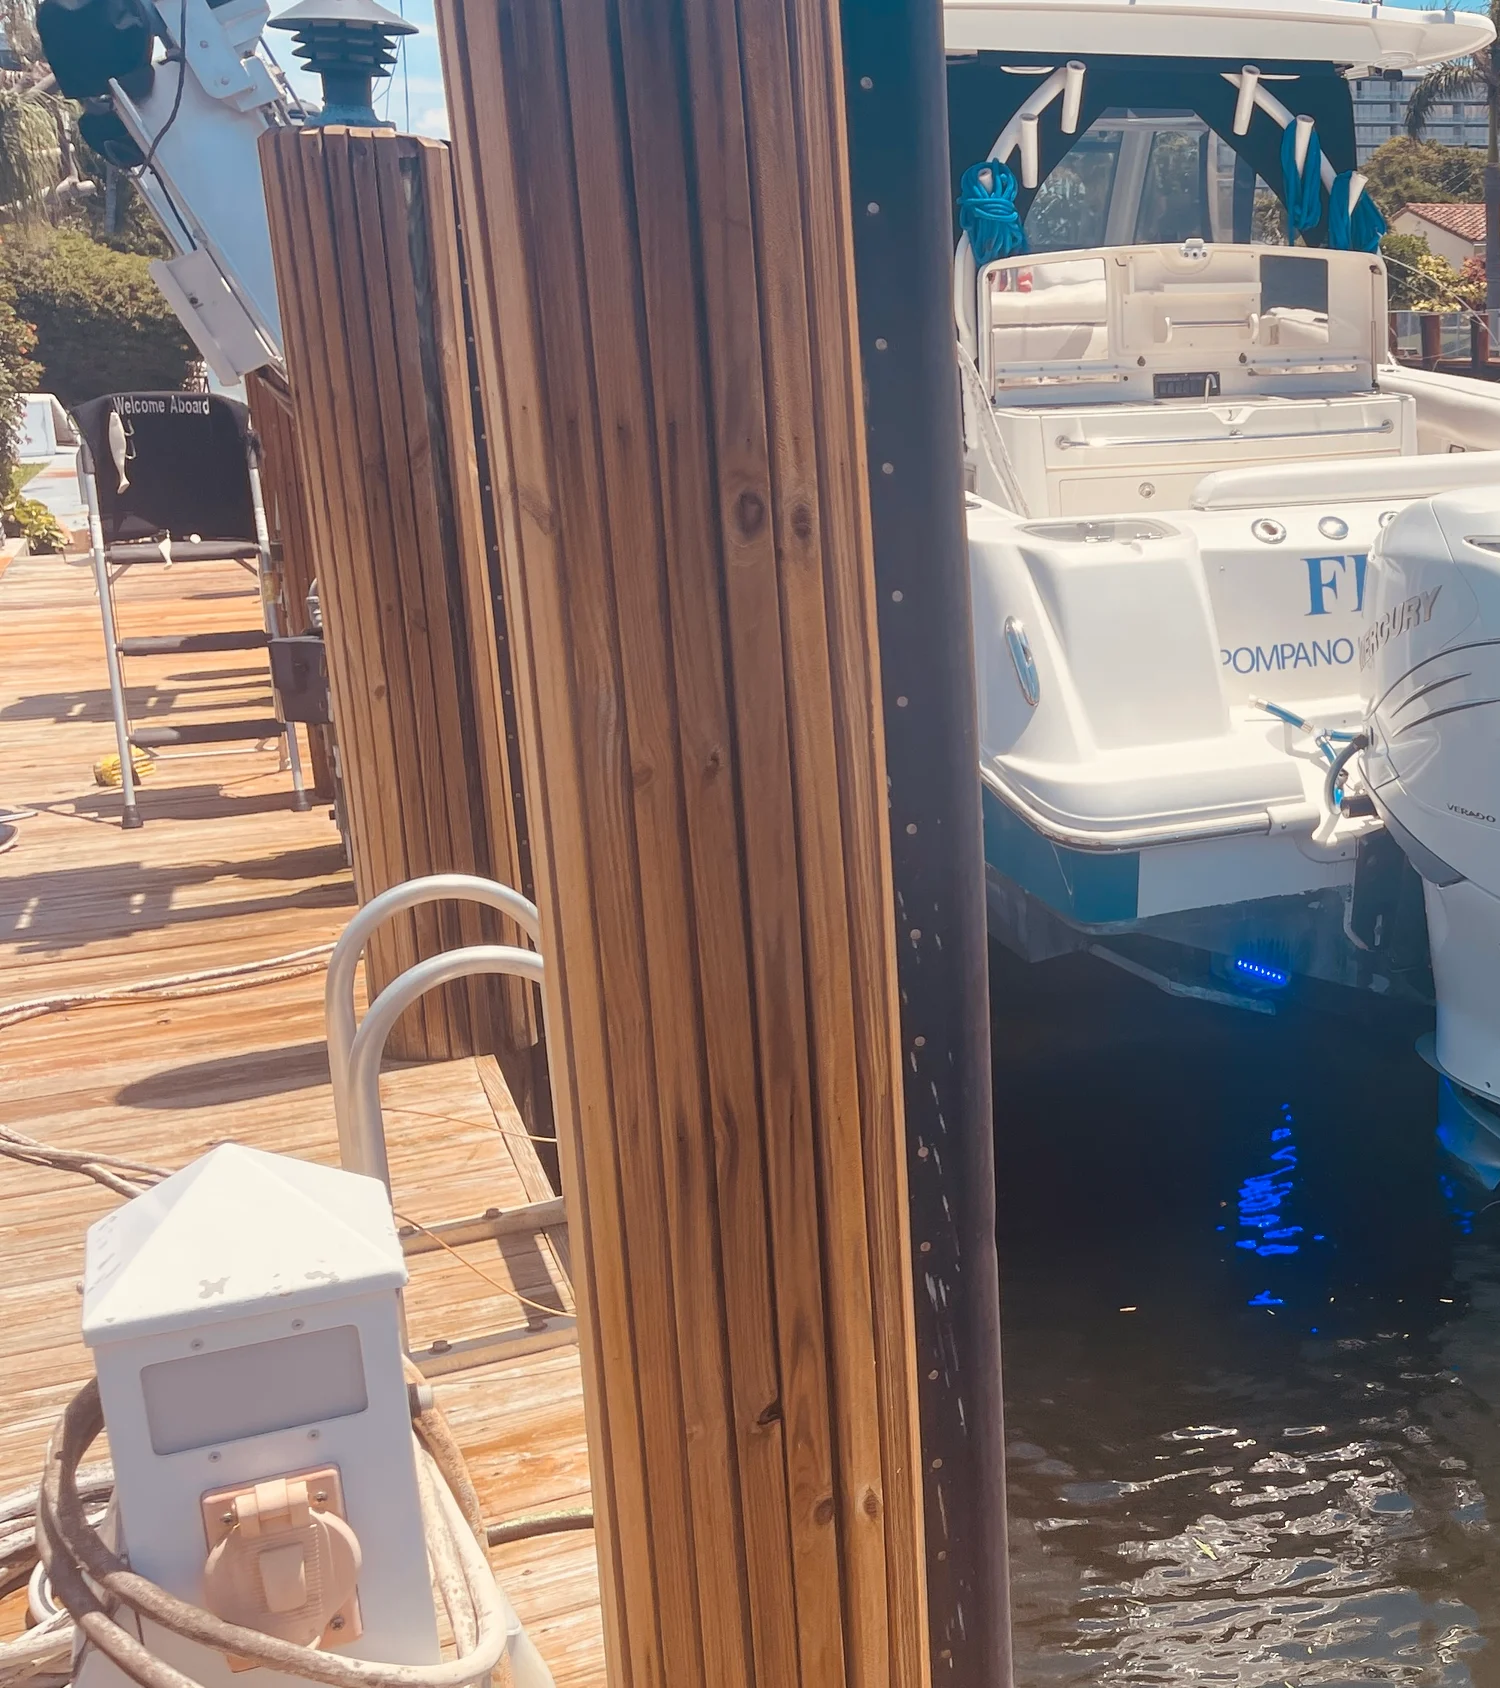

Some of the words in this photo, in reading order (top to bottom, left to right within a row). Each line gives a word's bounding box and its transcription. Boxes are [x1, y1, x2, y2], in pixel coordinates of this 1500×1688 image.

[112, 395, 166, 416] Welcome
[170, 394, 210, 416] Aboard
[1445, 802, 1497, 823] VERADO
